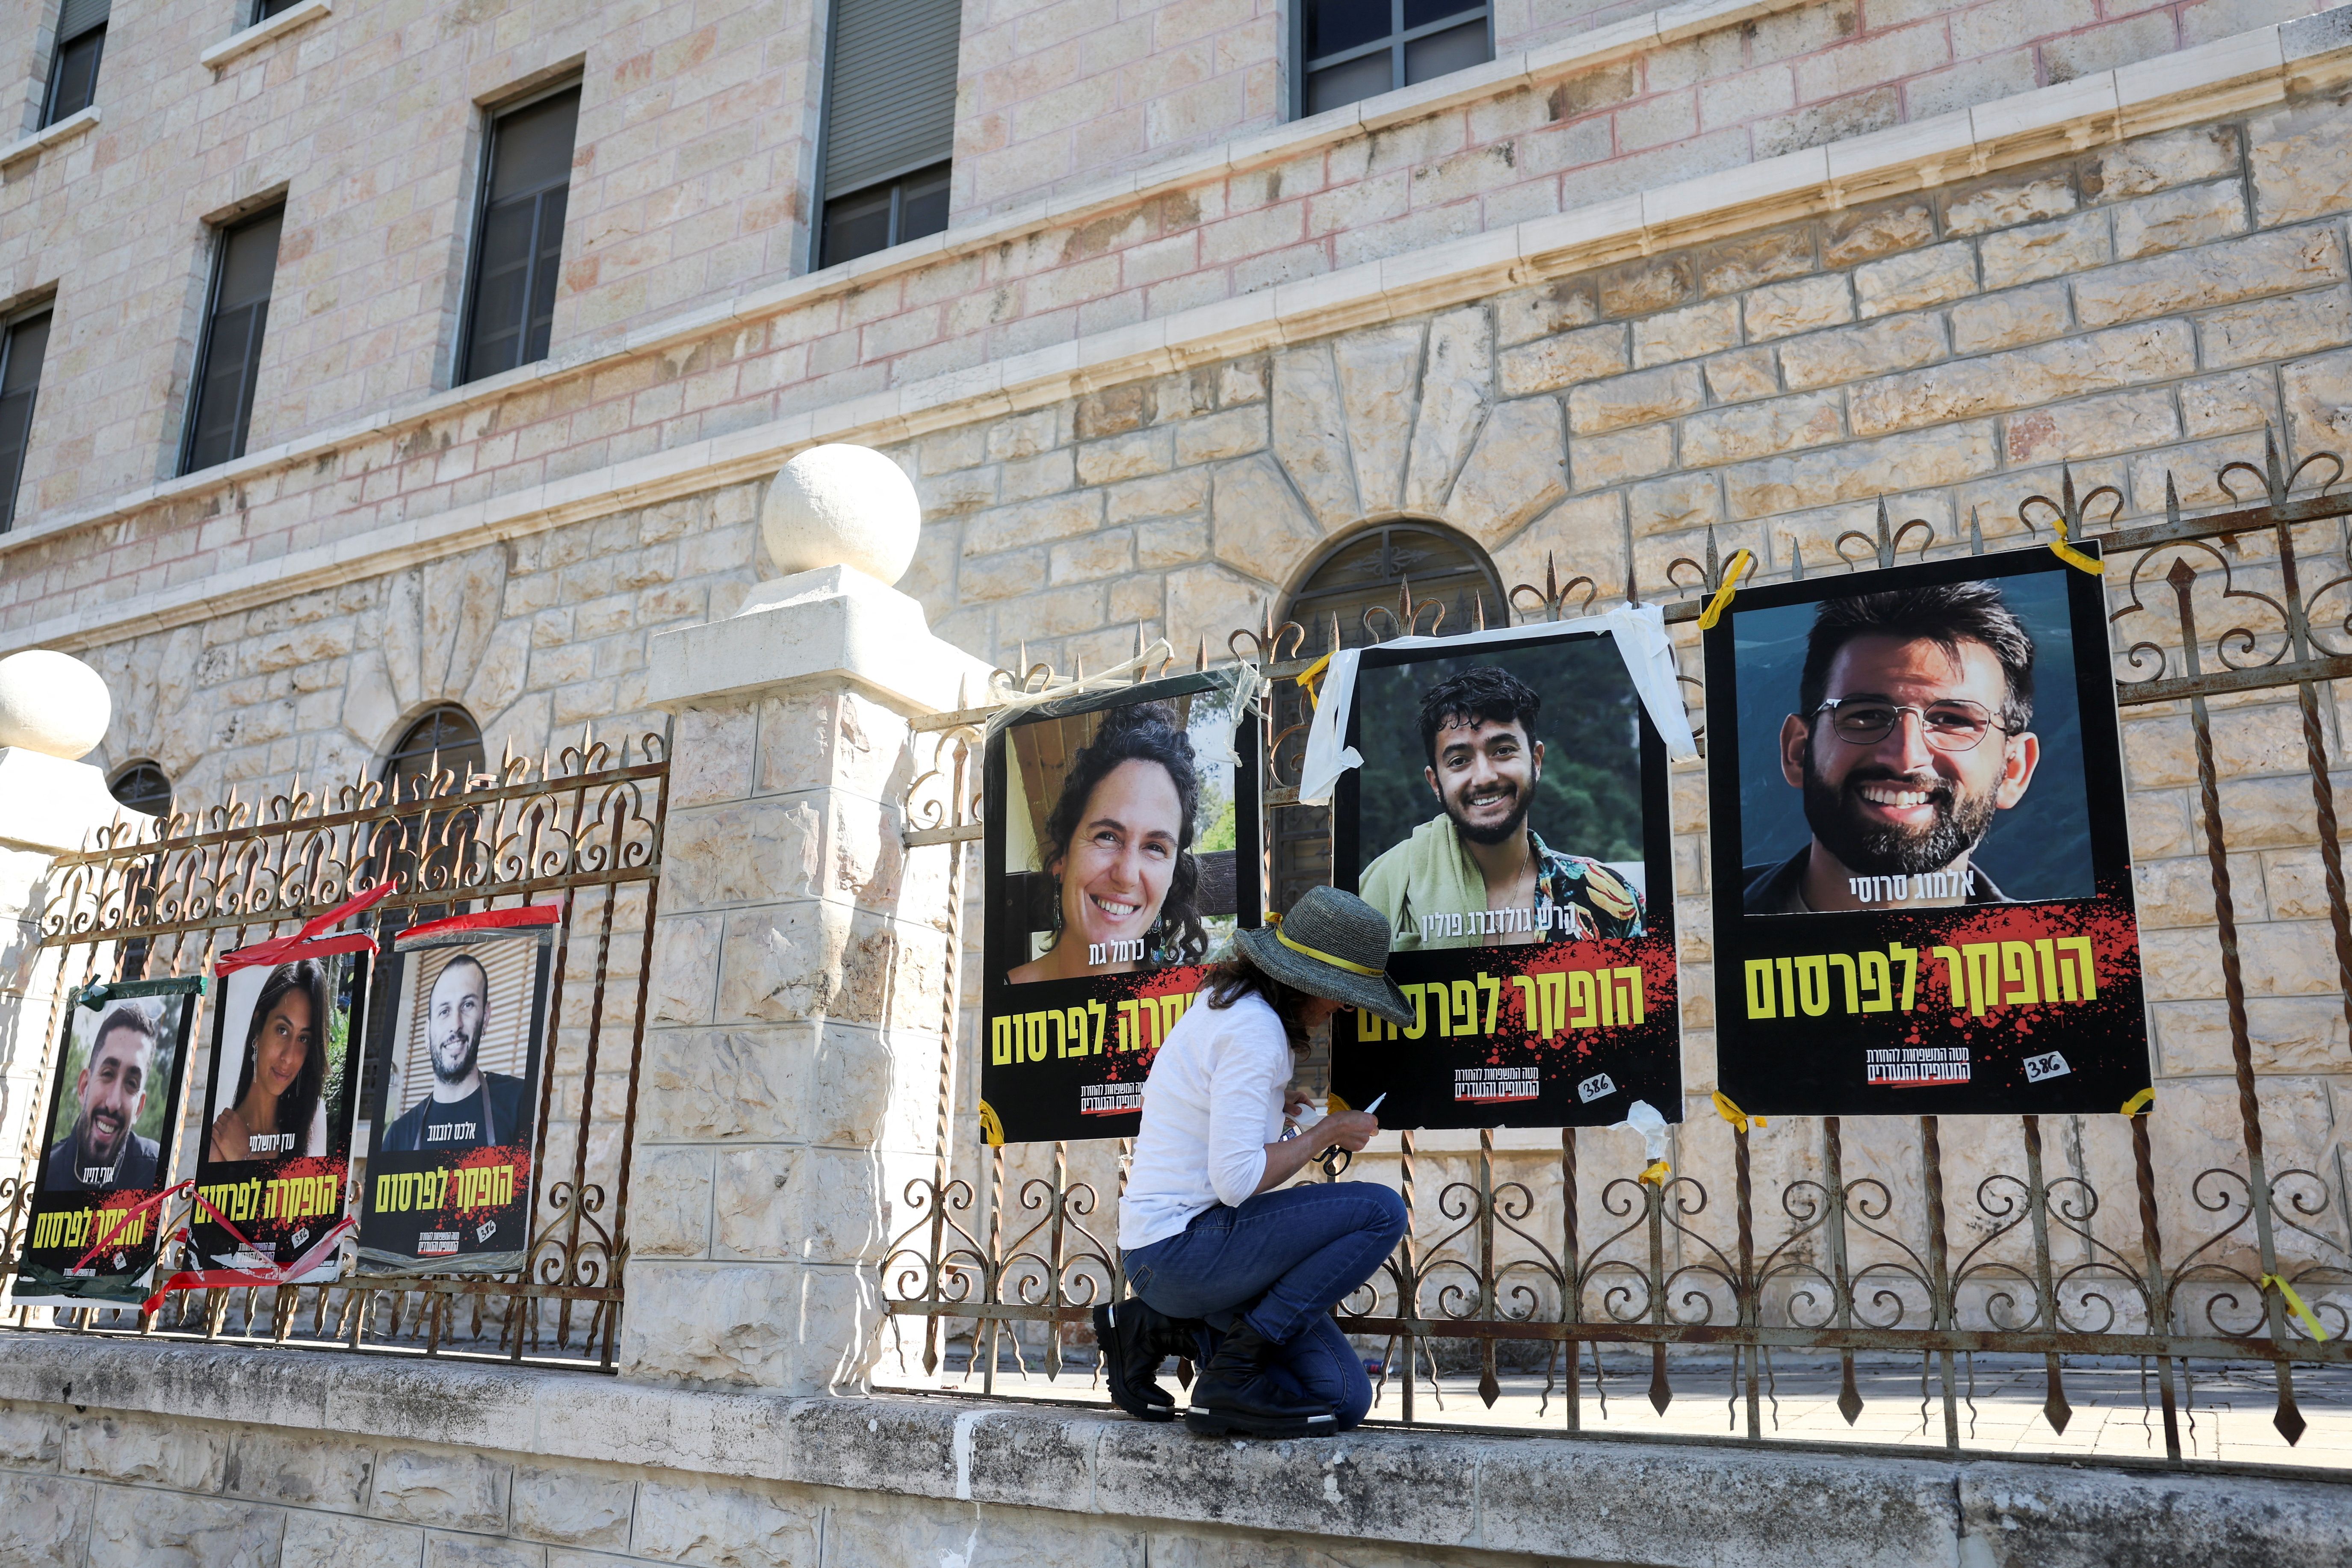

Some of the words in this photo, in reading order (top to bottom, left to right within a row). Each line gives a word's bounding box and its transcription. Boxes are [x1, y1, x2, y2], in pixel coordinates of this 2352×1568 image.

[1848, 872, 1909, 904] סרוסי
[1912, 868, 1976, 901] אלמוג
[1421, 911, 1463, 942] פולין
[1467, 907, 1531, 936] גולדברג
[1537, 904, 1577, 931] הרש
[1088, 942, 1108, 966] גת
[1111, 938, 1144, 966] כרמל
[1745, 942, 1918, 1019] לפרסום
[1933, 936, 2097, 1016] הופקר
[1513, 967, 1644, 1039] הופקר
[993, 999, 1106, 1065] לפרסום
[1866, 1048, 1900, 1063] להחזרת
[1902, 1048, 1947, 1062] המשפחות
[1948, 1047, 1970, 1061] מטה
[1455, 1068, 1483, 1081] להחזרת
[1483, 1068, 1521, 1080] המשפחות
[1522, 1067, 1539, 1079] מטה
[1867, 1064, 1918, 1081] והנעדרים
[1921, 1063, 1971, 1080] החטופים
[2027, 1055, 2061, 1078] 386
[1081, 1084, 1104, 1097] להחזרת
[1104, 1082, 1134, 1095] המשפחות
[1455, 1082, 1496, 1098] והנעדרים
[1498, 1081, 1539, 1097] החטופים
[1584, 1075, 1608, 1097] 386
[1081, 1096, 1114, 1111] והנעדרים
[427, 1123, 452, 1142] לובנוב
[455, 1121, 476, 1140] אלכס
[249, 1134, 280, 1152] ירושלמי
[281, 1133, 295, 1152] עדן
[83, 1167, 99, 1183] דנינו
[100, 1167, 115, 1182] אורי
[376, 1166, 449, 1212] לפרסום
[454, 1165, 513, 1212] הופקר
[264, 1174, 337, 1223] הופקרה
[33, 1206, 92, 1248] לפרסום
[481, 1221, 494, 1239] 386
[295, 1229, 307, 1245] 386
